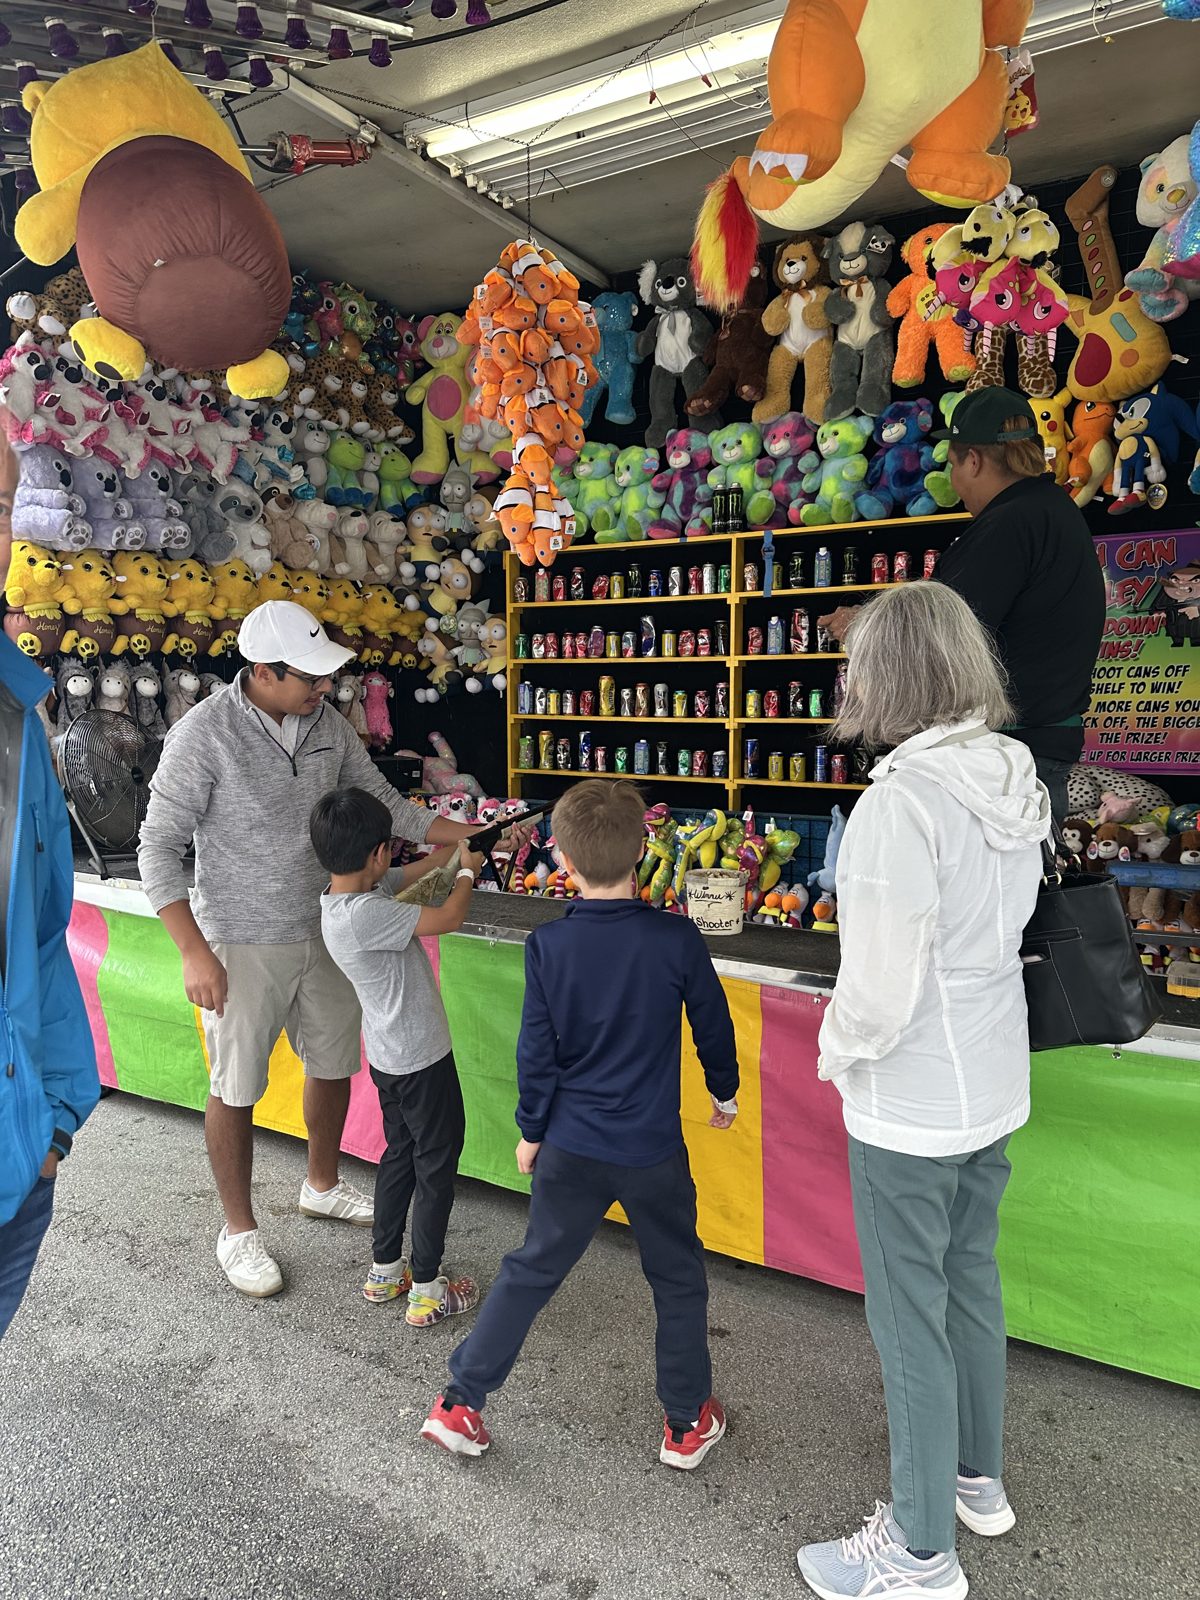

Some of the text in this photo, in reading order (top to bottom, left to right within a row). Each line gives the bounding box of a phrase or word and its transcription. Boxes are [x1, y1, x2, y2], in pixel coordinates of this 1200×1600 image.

[1116, 537, 1176, 570] CAN
[1105, 576, 1157, 608] LEY
[36, 621, 61, 635] Honey
[93, 625, 115, 638] Honey
[1103, 616, 1161, 636] DOWN
[1099, 639, 1144, 659] INS!
[1091, 664, 1190, 679] HOOT CANS OFF
[1129, 681, 1146, 694] TO
[1150, 680, 1183, 694] WIN!
[1094, 700, 1132, 713] MORE
[1135, 700, 1169, 713] CANS
[1174, 699, 1200, 713] YOU
[1103, 716, 1129, 730] OFF,
[1135, 716, 1158, 728] THE
[1162, 716, 1200, 729] BIGGE
[1099, 731, 1168, 744] THE PRIZE!
[1088, 750, 1104, 760] UP
[1105, 750, 1127, 761] FOR
[1129, 751, 1171, 762] LARGER
[1174, 751, 1200, 763] PRIZ
[696, 915, 734, 929] Shooter
